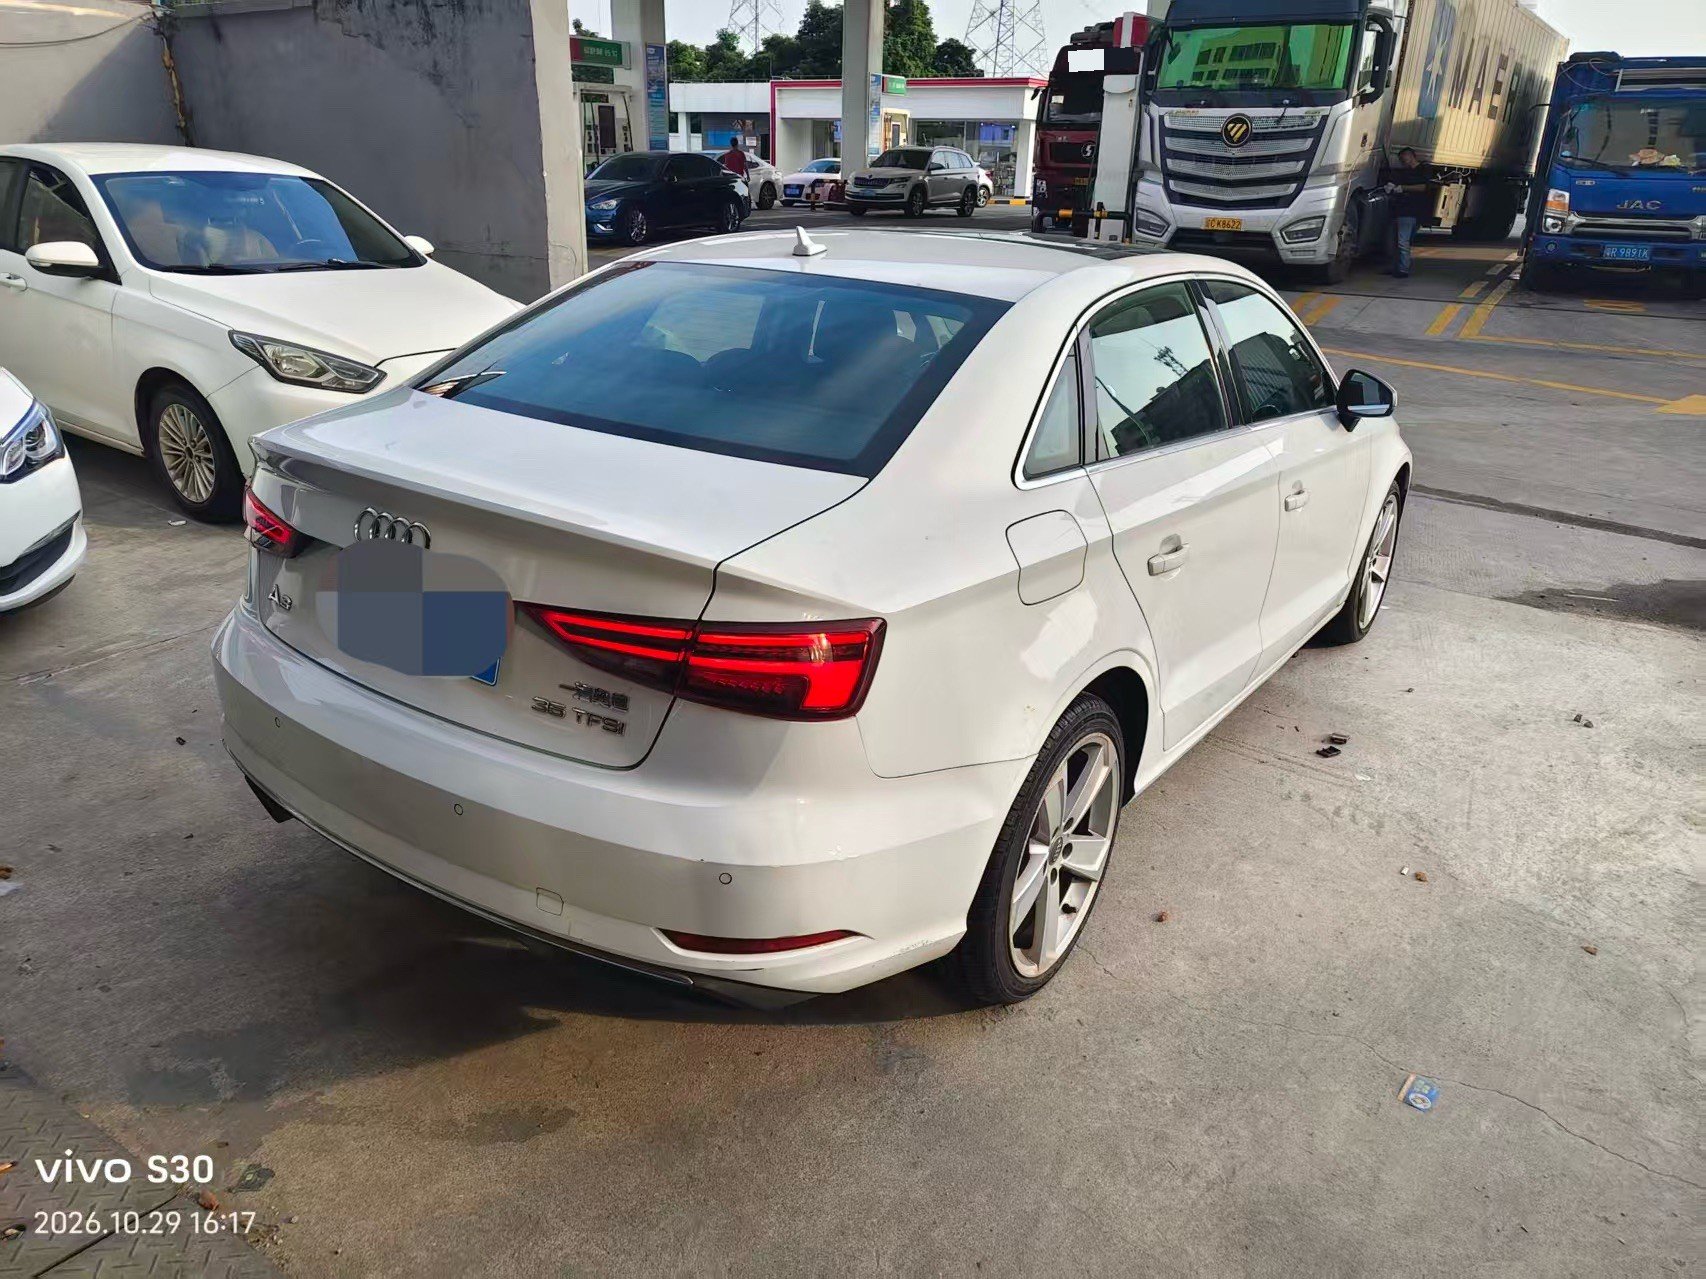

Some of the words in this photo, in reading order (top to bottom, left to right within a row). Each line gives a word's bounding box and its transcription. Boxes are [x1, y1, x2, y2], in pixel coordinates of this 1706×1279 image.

[1616, 199, 1661, 210] JAC
[268, 583, 292, 611] A3
[532, 696, 566, 718] 35
[572, 706, 625, 735] TFSI
